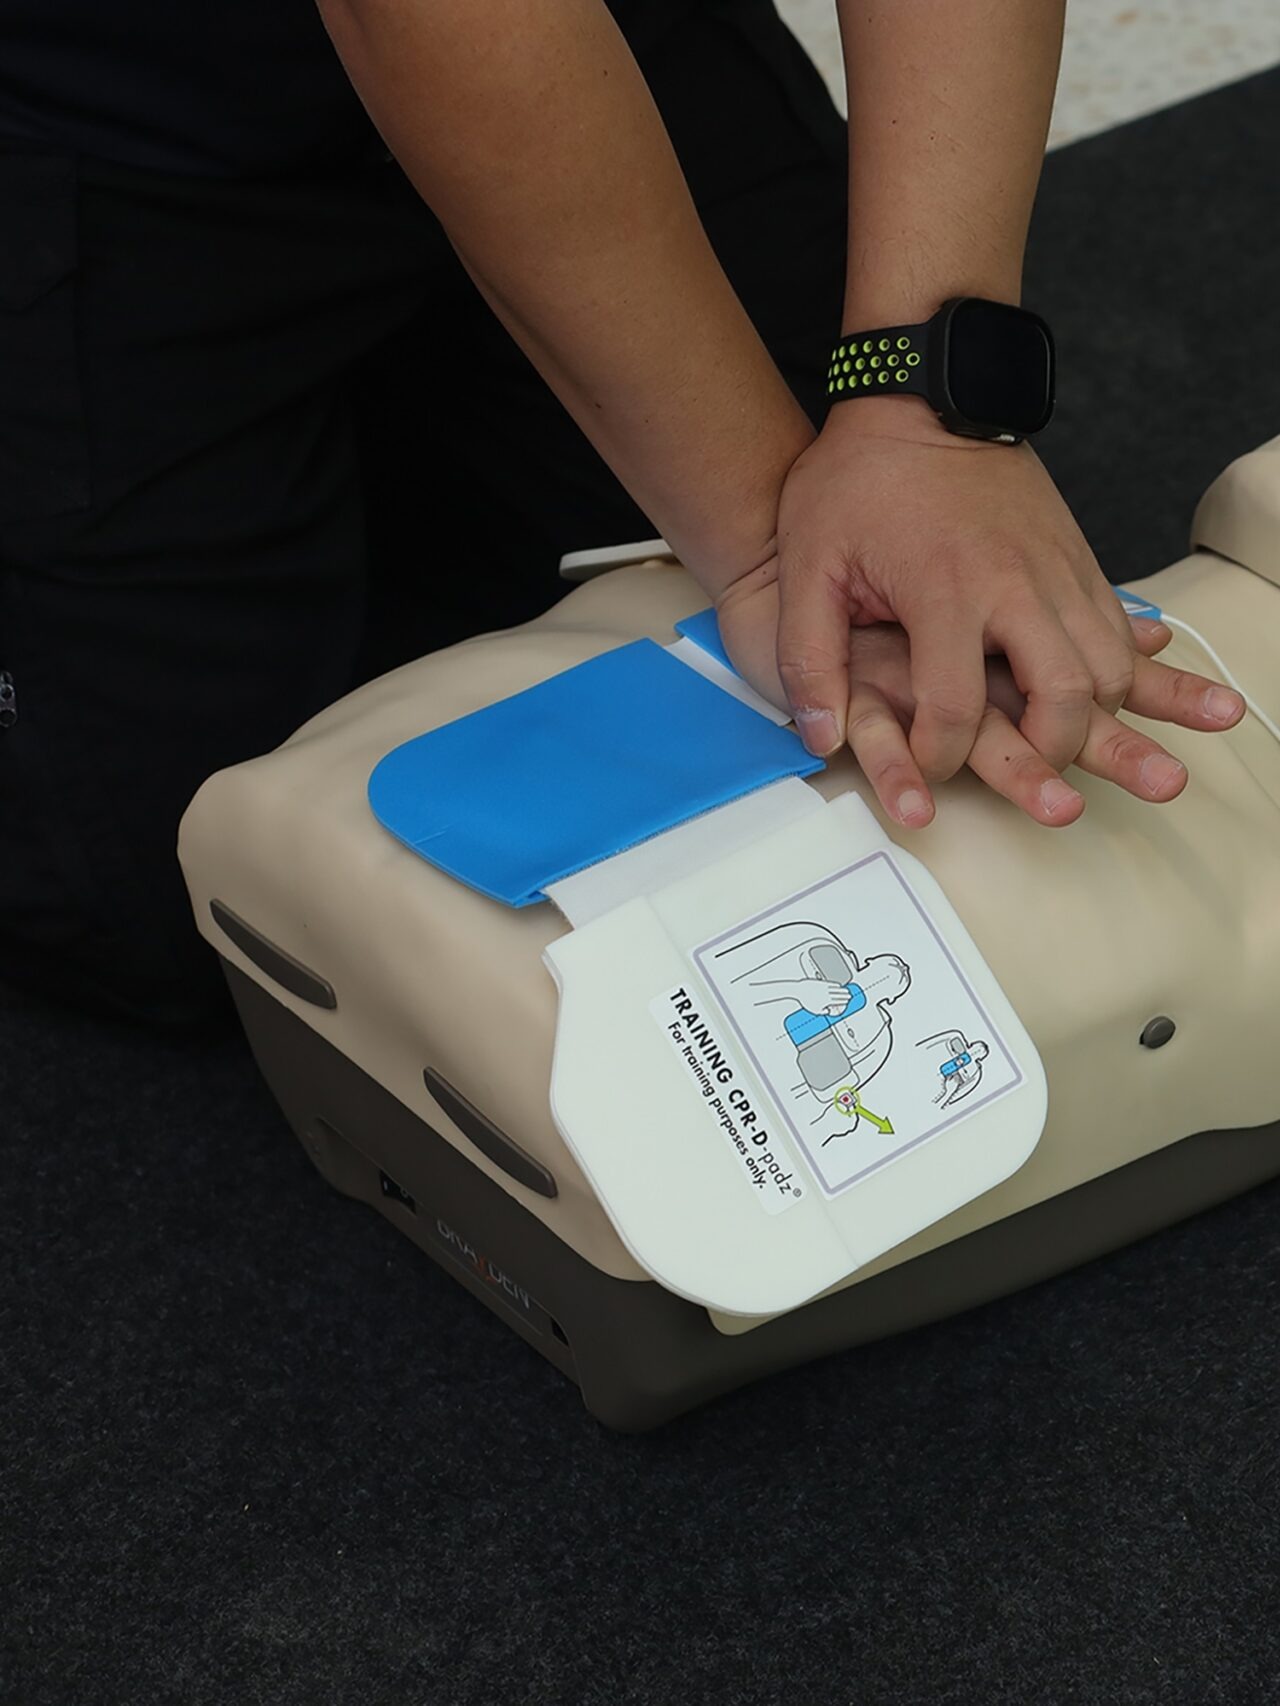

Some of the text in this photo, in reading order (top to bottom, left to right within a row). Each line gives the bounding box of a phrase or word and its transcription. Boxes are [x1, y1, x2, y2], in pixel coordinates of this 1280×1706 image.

[670, 988, 733, 1084] TRAINING
[668, 1021, 767, 1189] For training purposes only.
